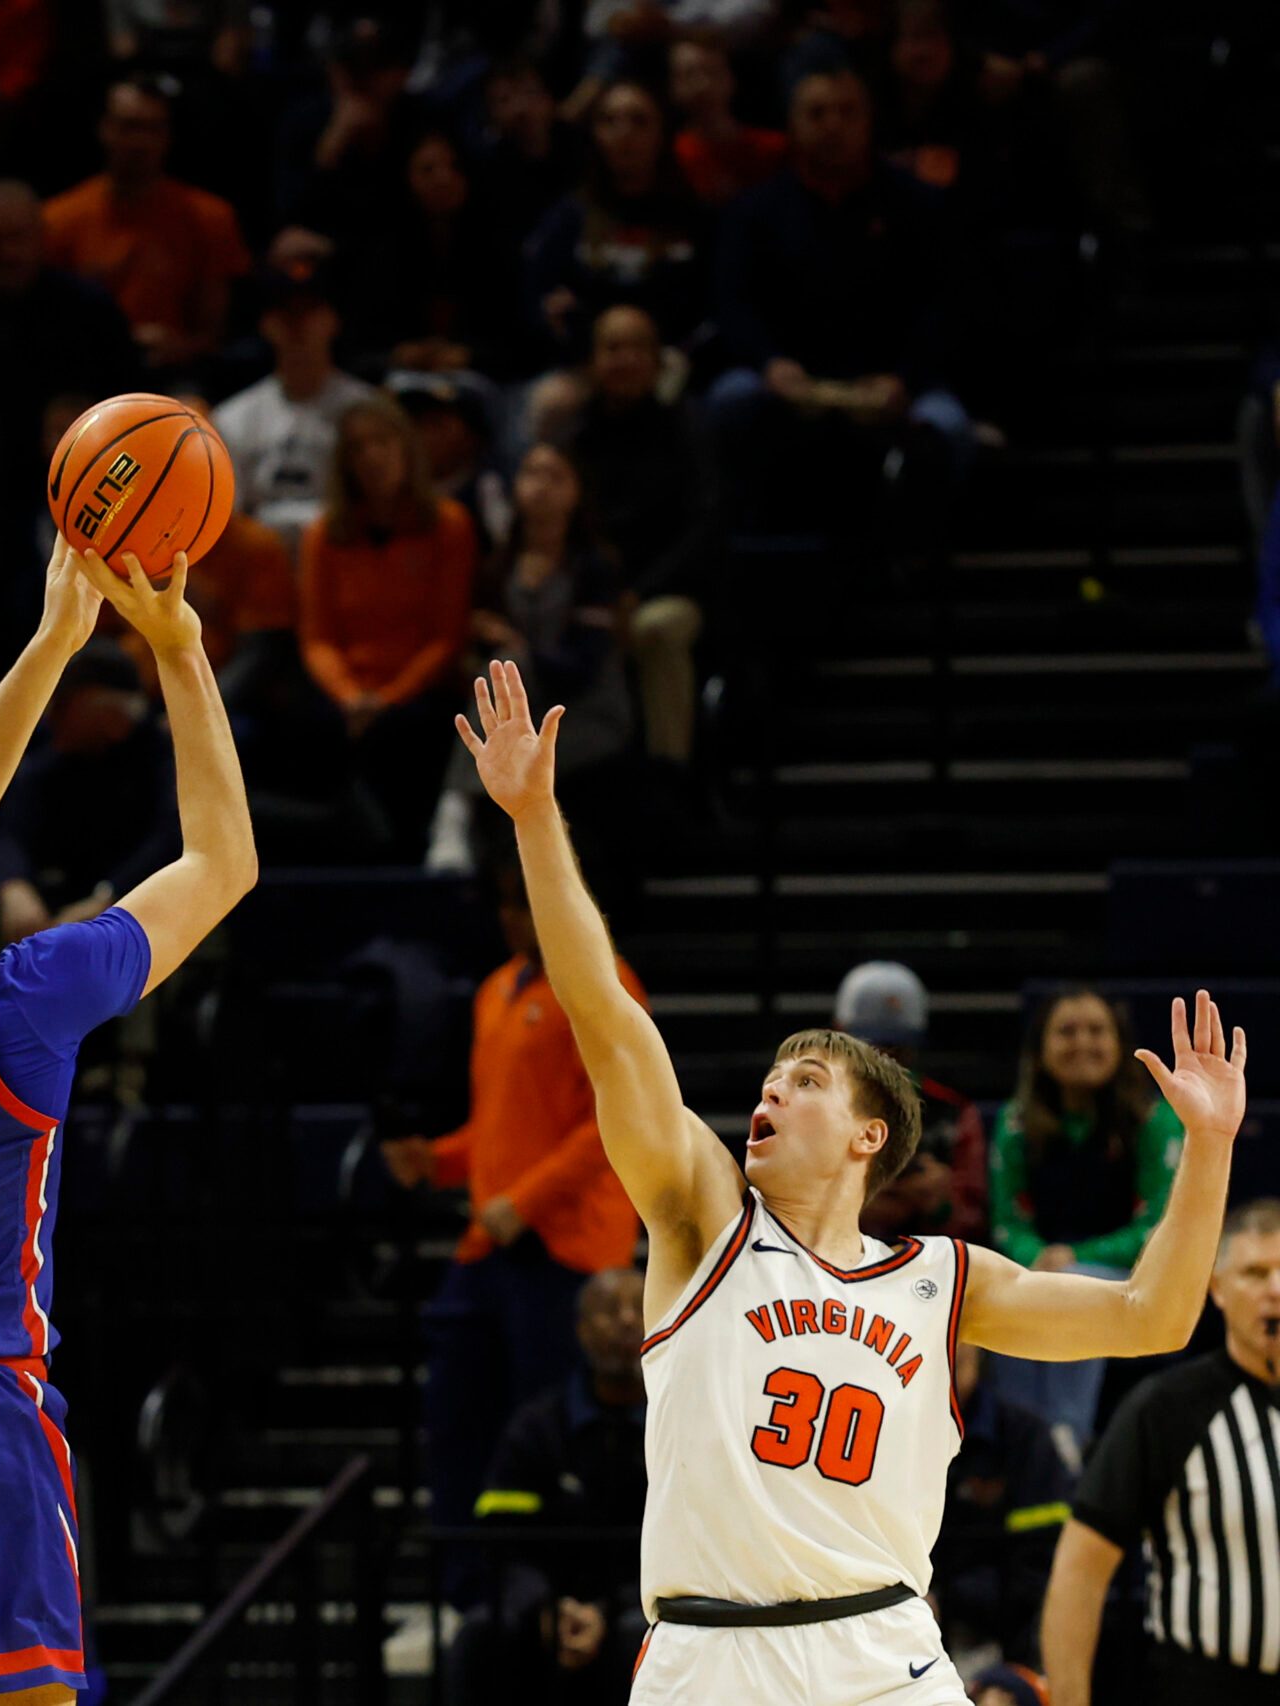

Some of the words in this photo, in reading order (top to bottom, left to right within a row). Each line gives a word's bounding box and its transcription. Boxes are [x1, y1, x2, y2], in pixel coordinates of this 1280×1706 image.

[74, 451, 142, 541] ELITE
[744, 1298, 923, 1389] VIRGINIA
[751, 1366, 885, 1487] 30
